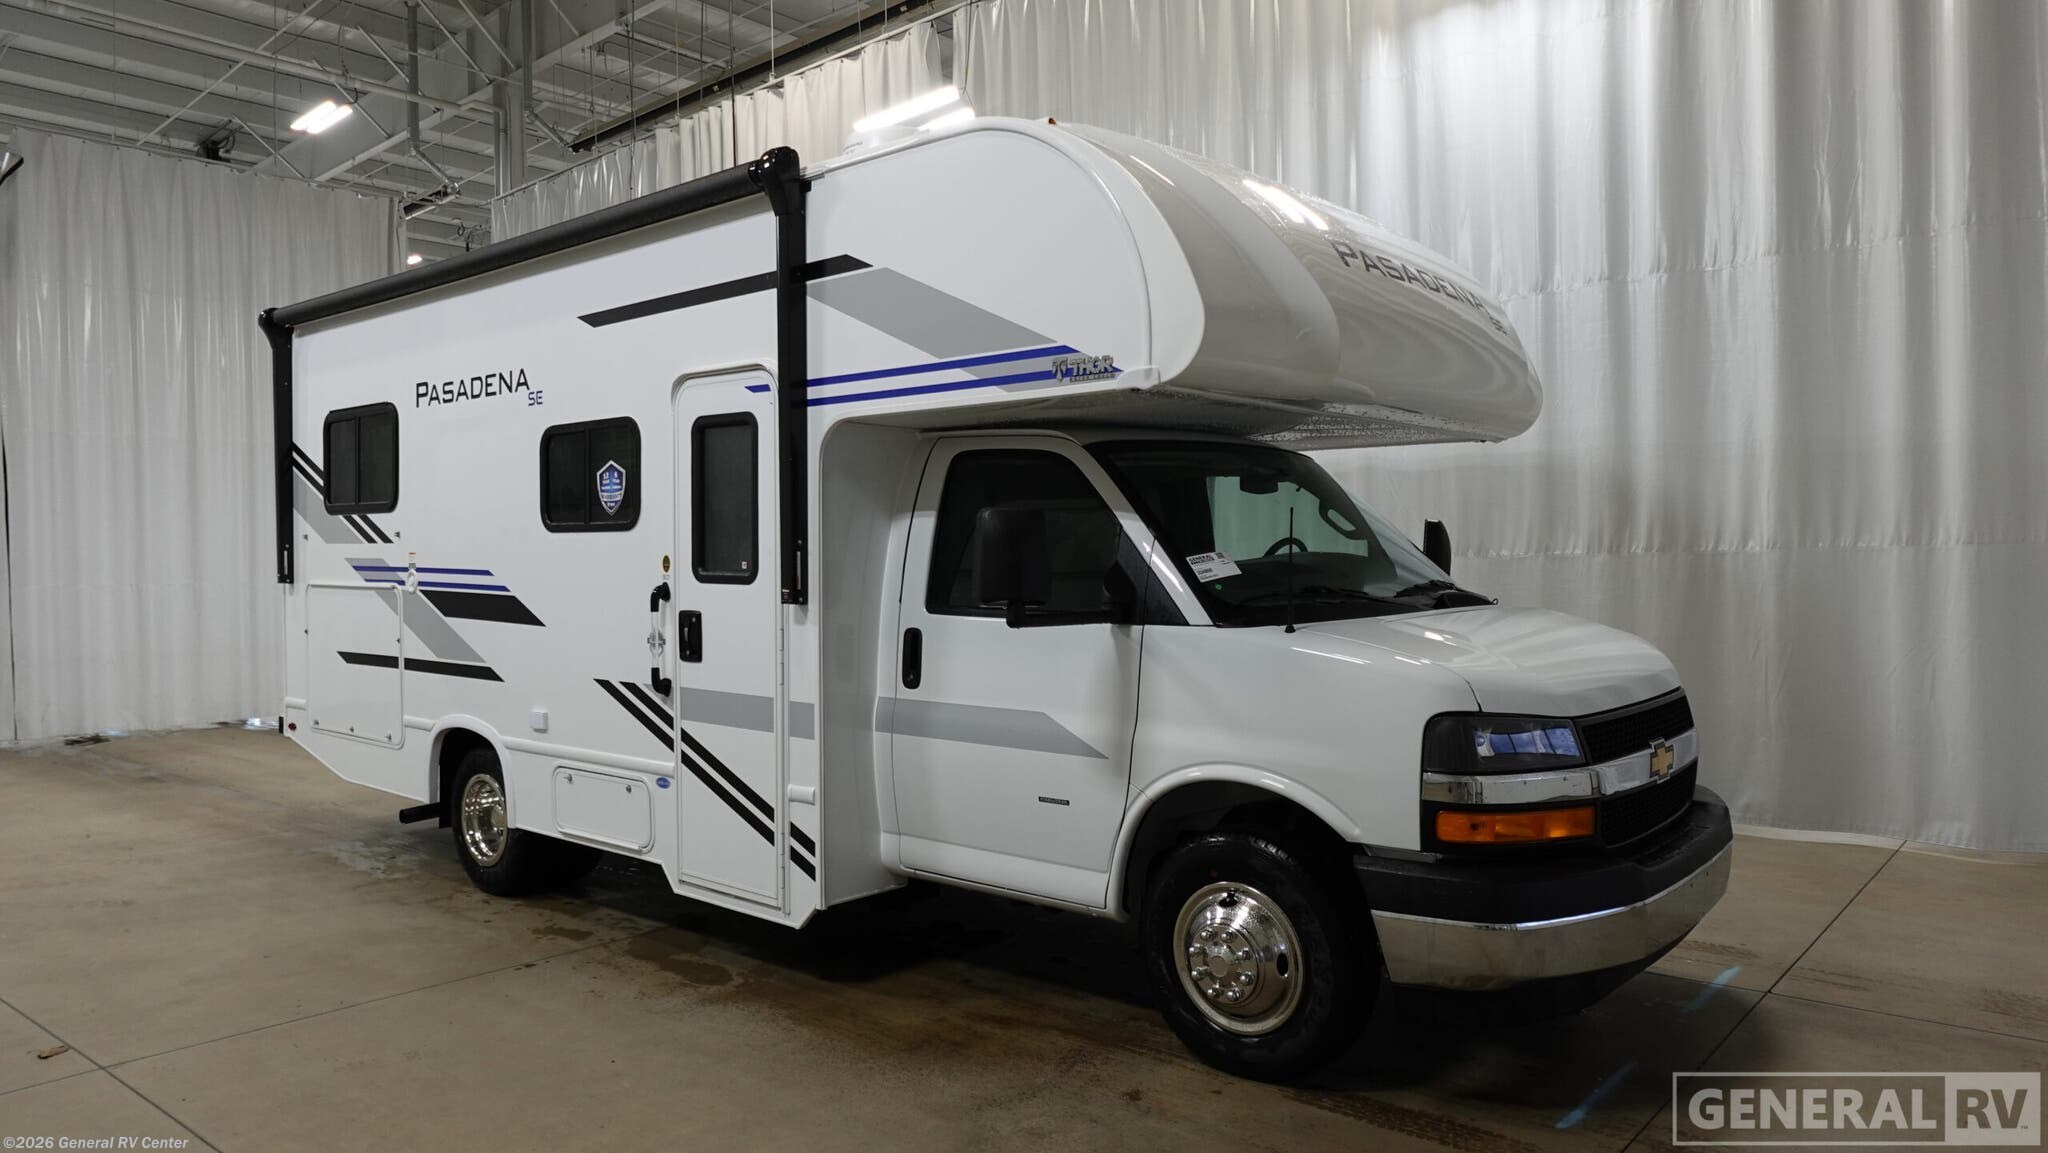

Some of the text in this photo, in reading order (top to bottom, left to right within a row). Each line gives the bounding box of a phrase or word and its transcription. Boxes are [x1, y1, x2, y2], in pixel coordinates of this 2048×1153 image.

[1331, 239, 1491, 316] PASADENA
[1069, 355, 1114, 377] THOR
[416, 368, 543, 408] PASADENA SE
